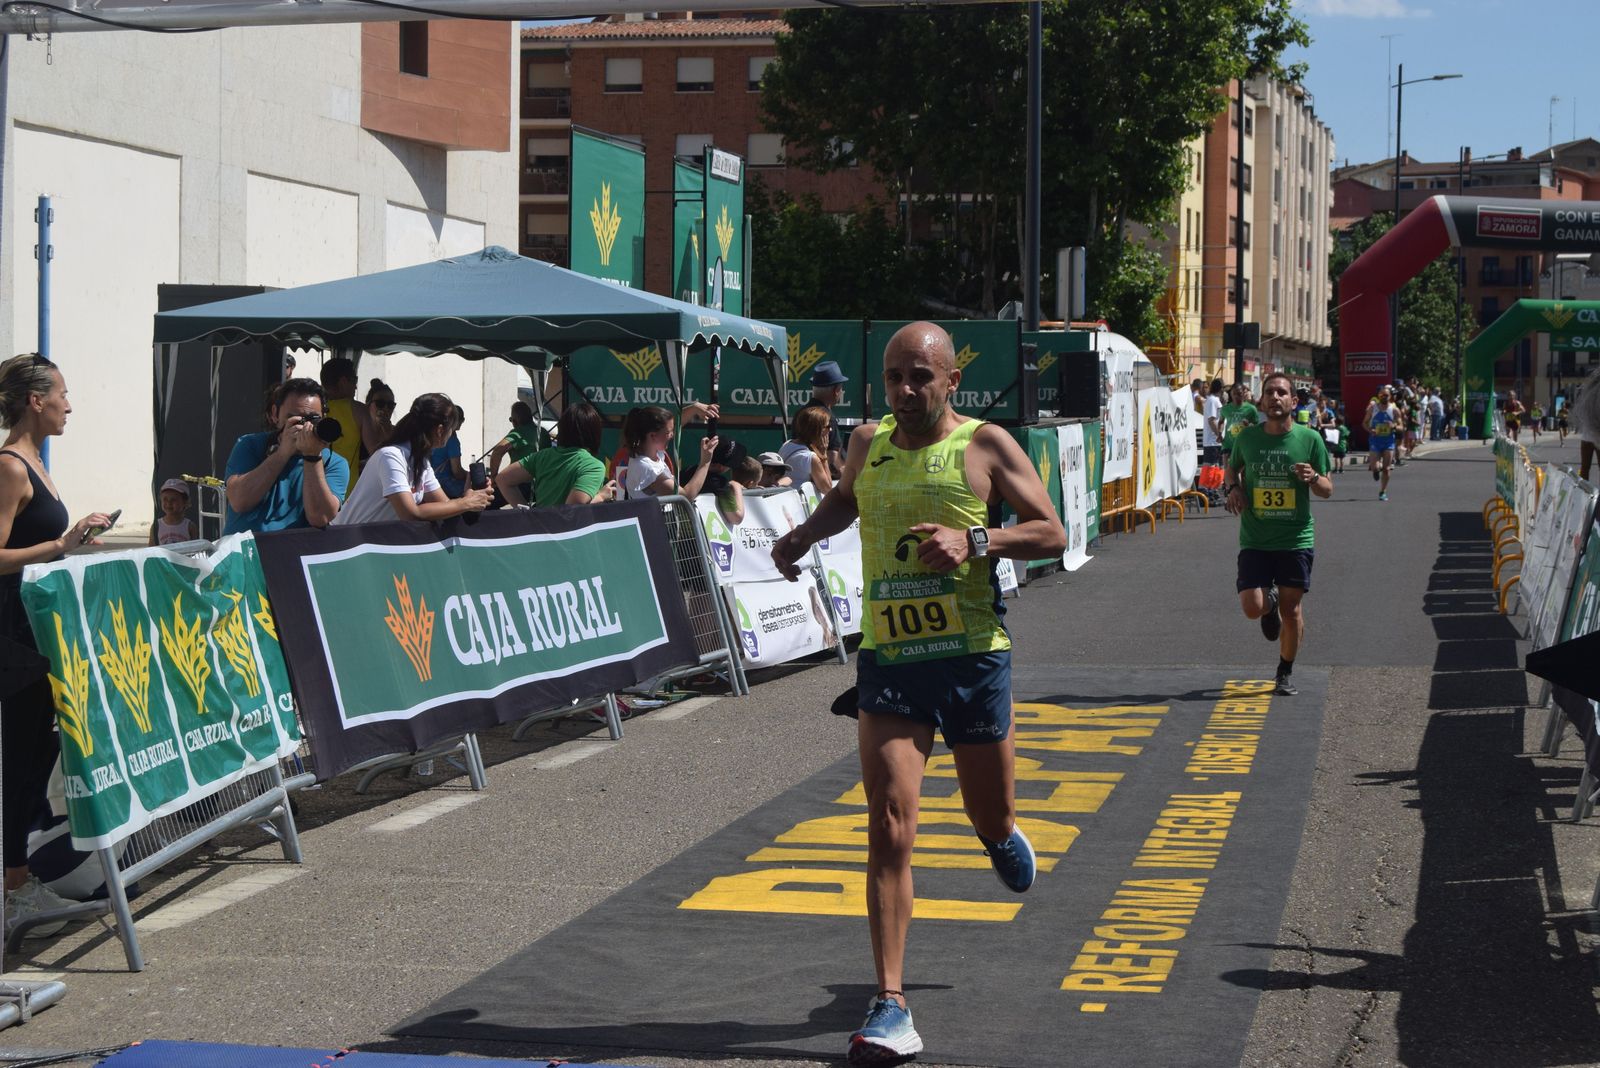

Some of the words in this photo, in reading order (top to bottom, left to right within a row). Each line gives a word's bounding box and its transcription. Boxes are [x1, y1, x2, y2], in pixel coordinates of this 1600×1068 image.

[1555, 210, 1587, 223] CON
[1492, 223, 1537, 233] ZAMORA
[1571, 336, 1600, 348] SA
[583, 386, 627, 403] CAJA
[731, 388, 778, 406] CAJA
[787, 389, 851, 407] RUL
[948, 390, 1007, 407] URAL
[1263, 491, 1284, 507] 33
[892, 590, 911, 598] CAJA
[913, 586, 943, 596] RURAL
[443, 591, 527, 667] CAJA
[517, 575, 623, 652] RURAL
[880, 602, 948, 638] 109
[902, 643, 926, 656] CAJA
[927, 640, 963, 653] RURAL
[203, 720, 232, 746] RUL
[147, 738, 179, 768] RURAL
[1184, 732, 1261, 774] DISEÑO
[64, 774, 93, 800] JA
[1132, 791, 1243, 869] INTEGRAL
[1059, 877, 1210, 993] REFORMA
